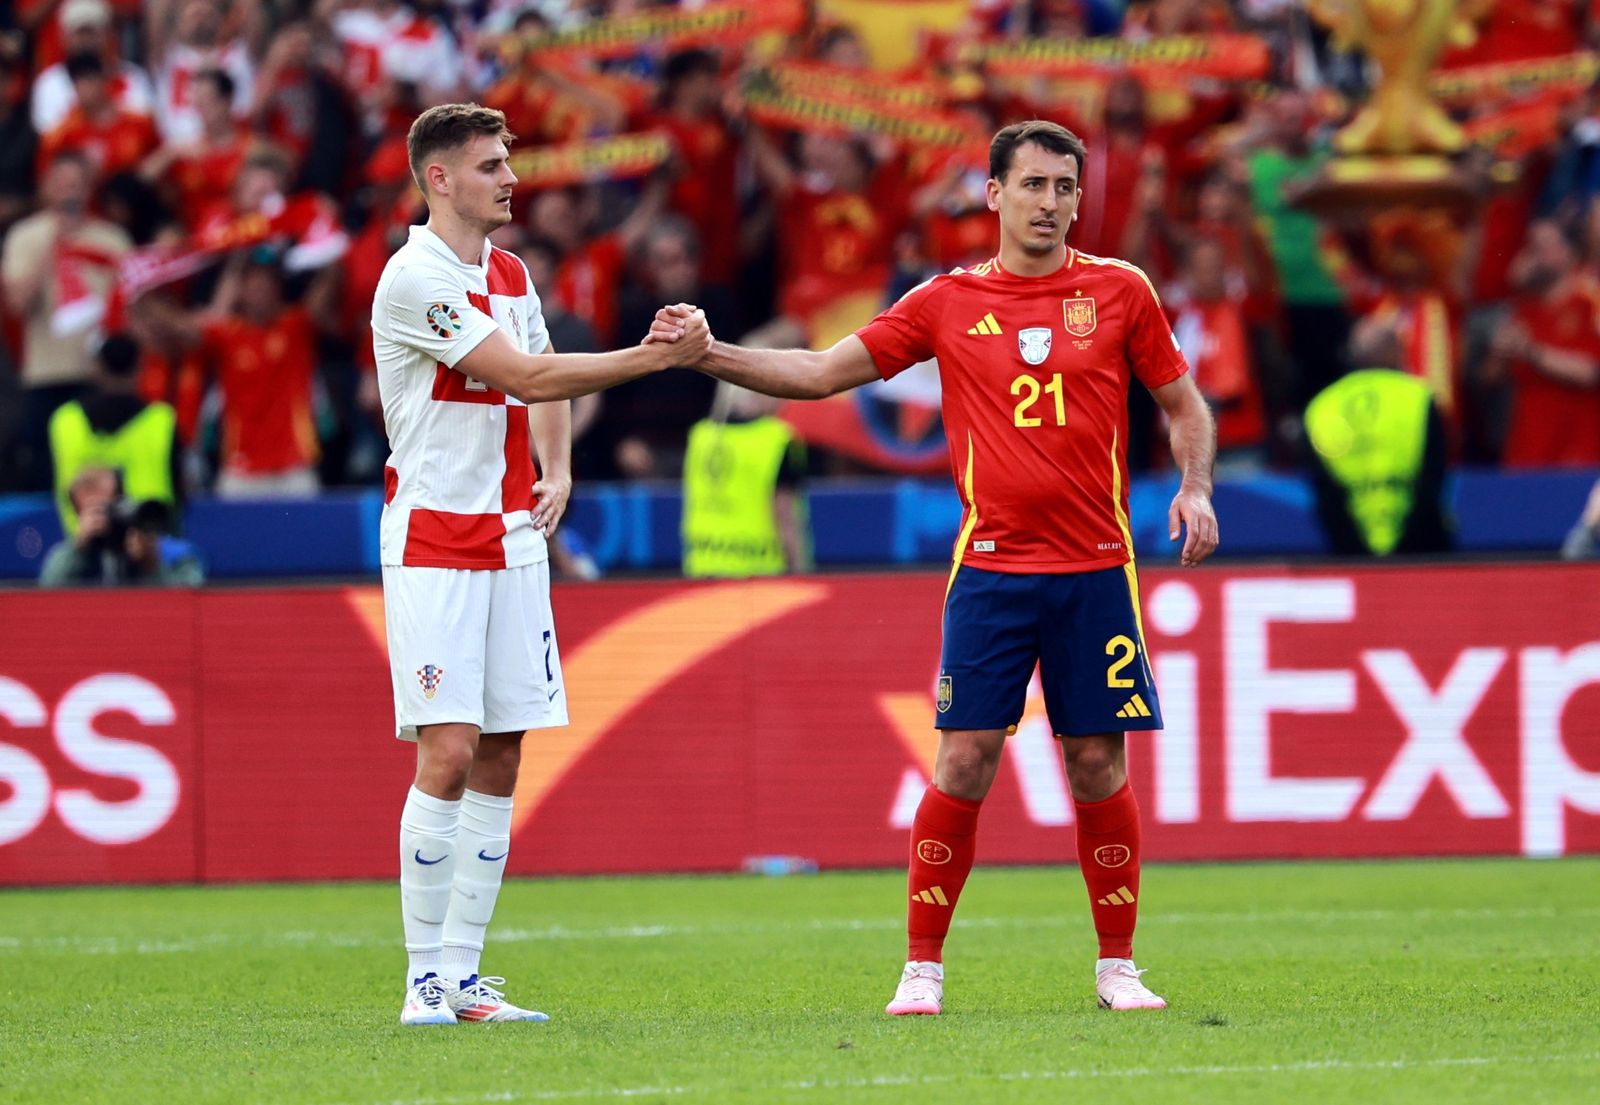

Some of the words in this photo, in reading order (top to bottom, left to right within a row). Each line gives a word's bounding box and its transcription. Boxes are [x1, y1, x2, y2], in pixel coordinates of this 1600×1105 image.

[1010, 373, 1067, 428] 21
[1105, 634, 1150, 688] 2
[891, 577, 1600, 858] iExp
